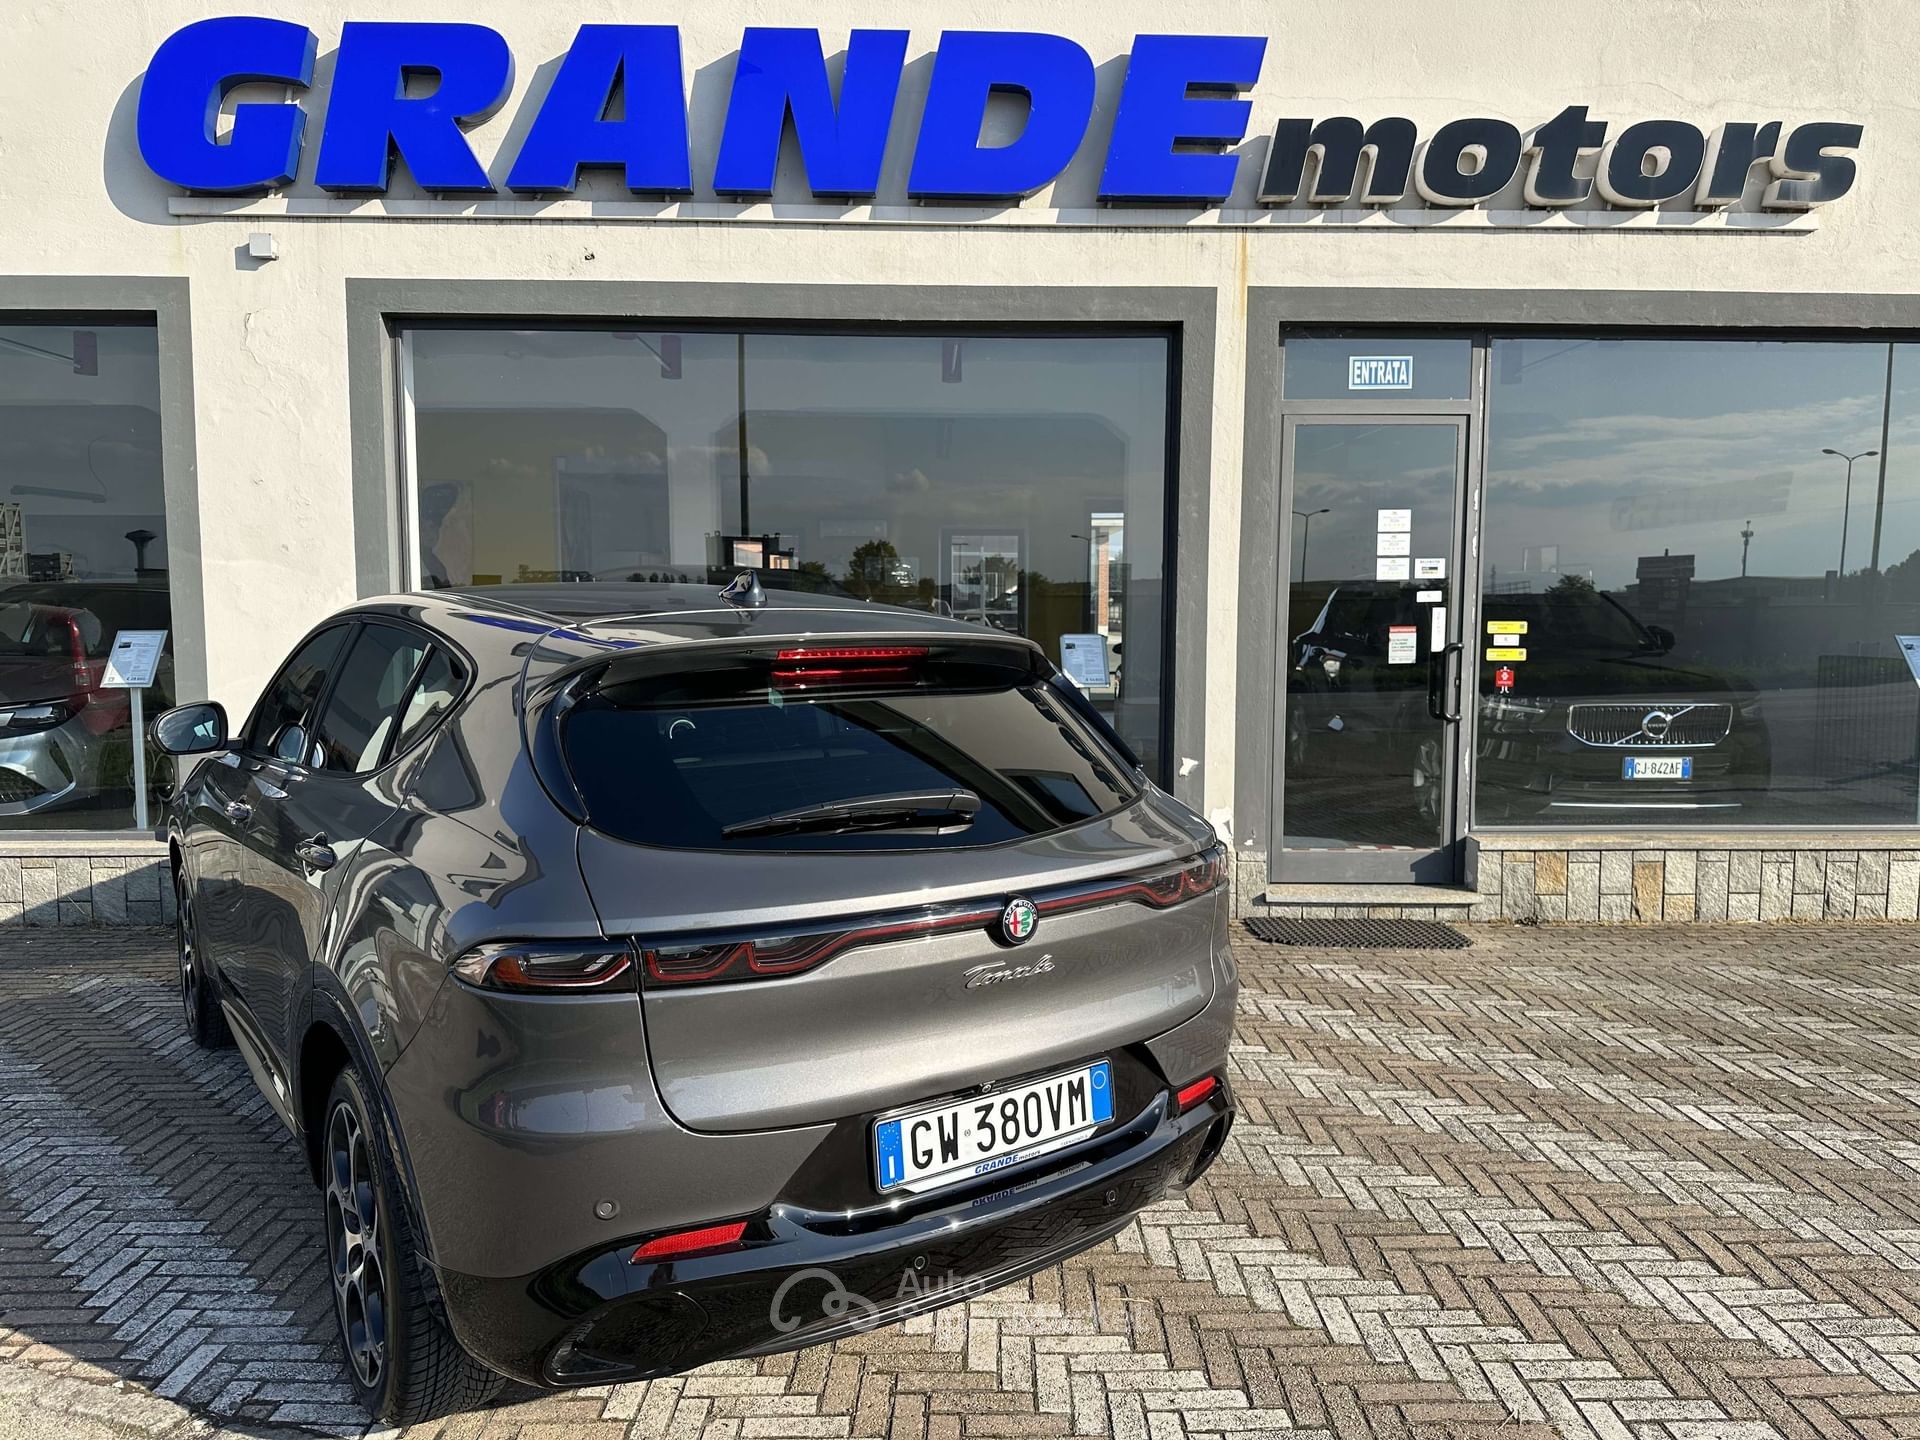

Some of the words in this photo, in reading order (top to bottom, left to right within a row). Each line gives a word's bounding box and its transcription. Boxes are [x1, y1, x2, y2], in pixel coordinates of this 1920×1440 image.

[137, 16, 1268, 200] GRANDE
[1258, 104, 1864, 206] motors
[1353, 360, 1408, 385] ENTRATA
[975, 1154, 1019, 1174] GRANDE
